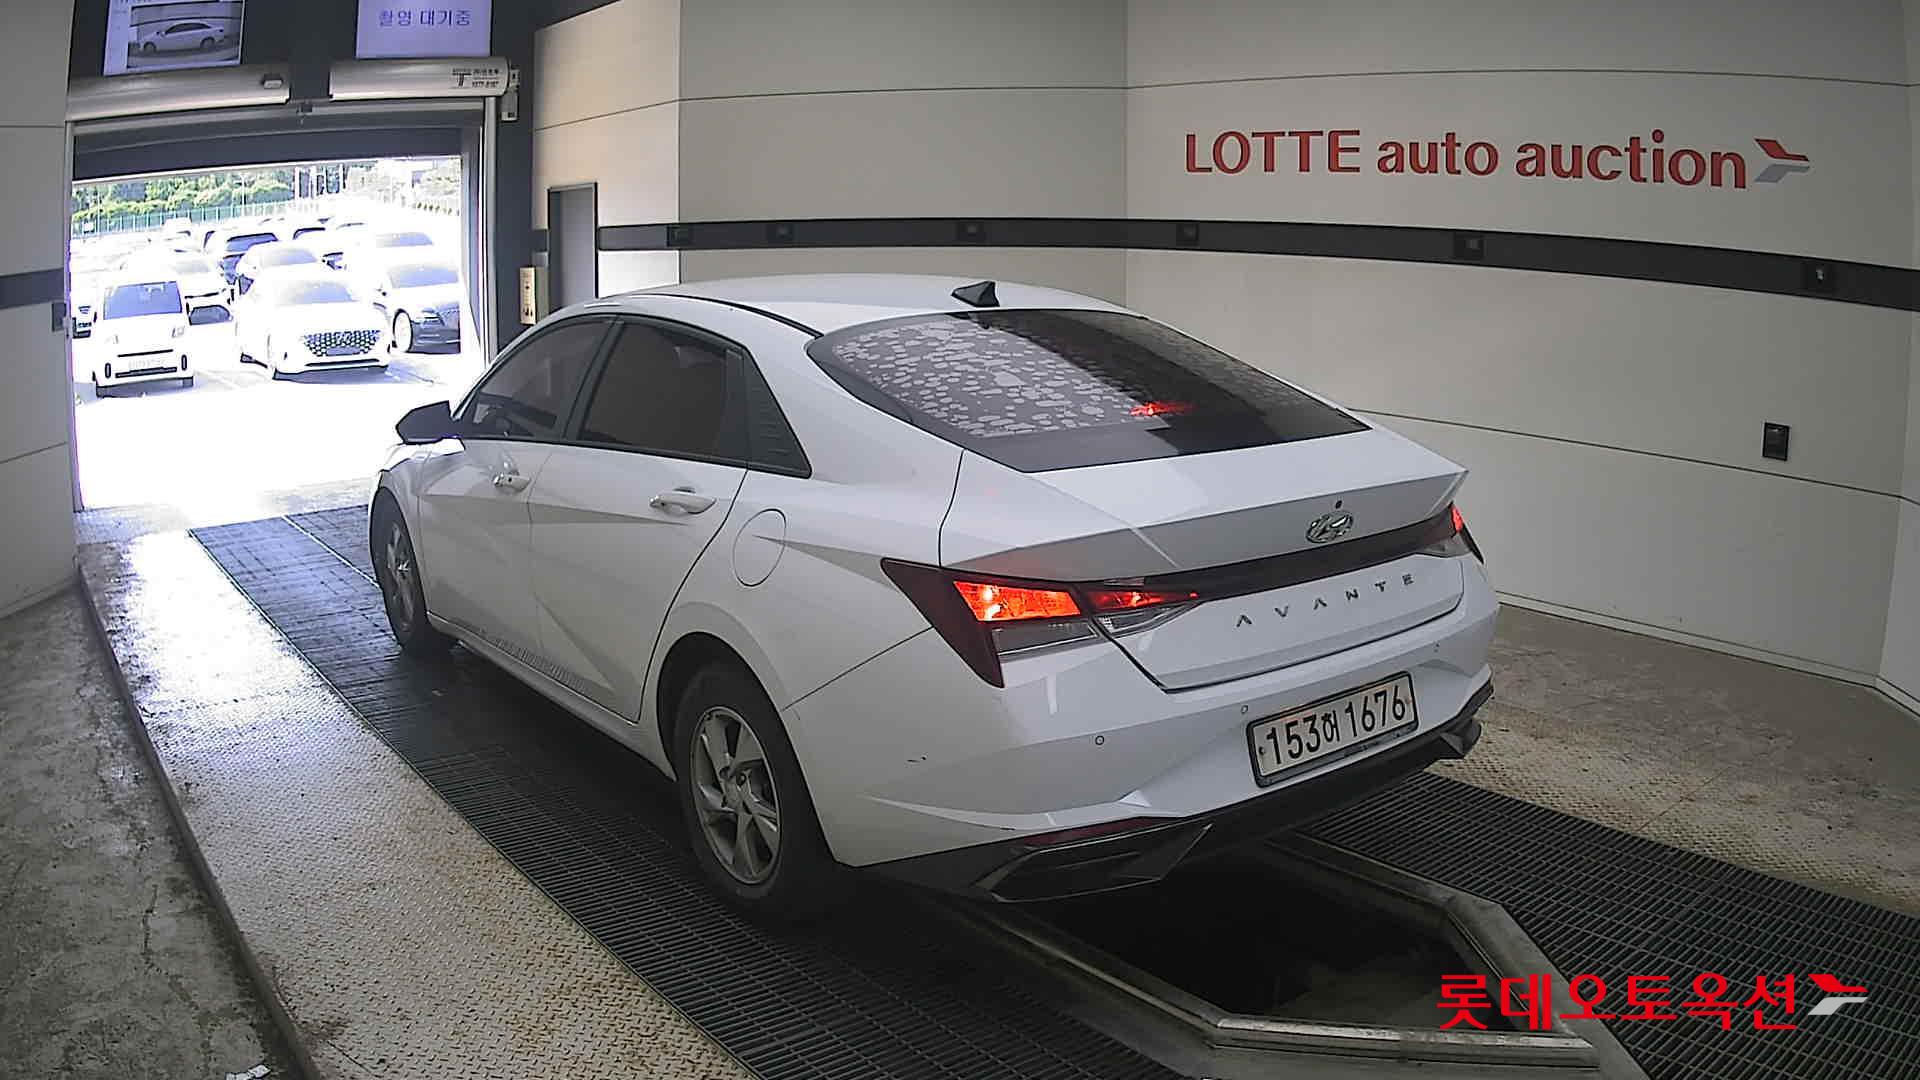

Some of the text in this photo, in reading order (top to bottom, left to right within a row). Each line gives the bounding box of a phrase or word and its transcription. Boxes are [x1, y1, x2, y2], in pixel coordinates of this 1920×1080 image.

[420, 9, 471, 27] 대기중
[1186, 130, 1747, 189] LOTTE auto auction
[1236, 573, 1414, 629] AVANTE
[1266, 684, 1406, 765] 153허 1676
